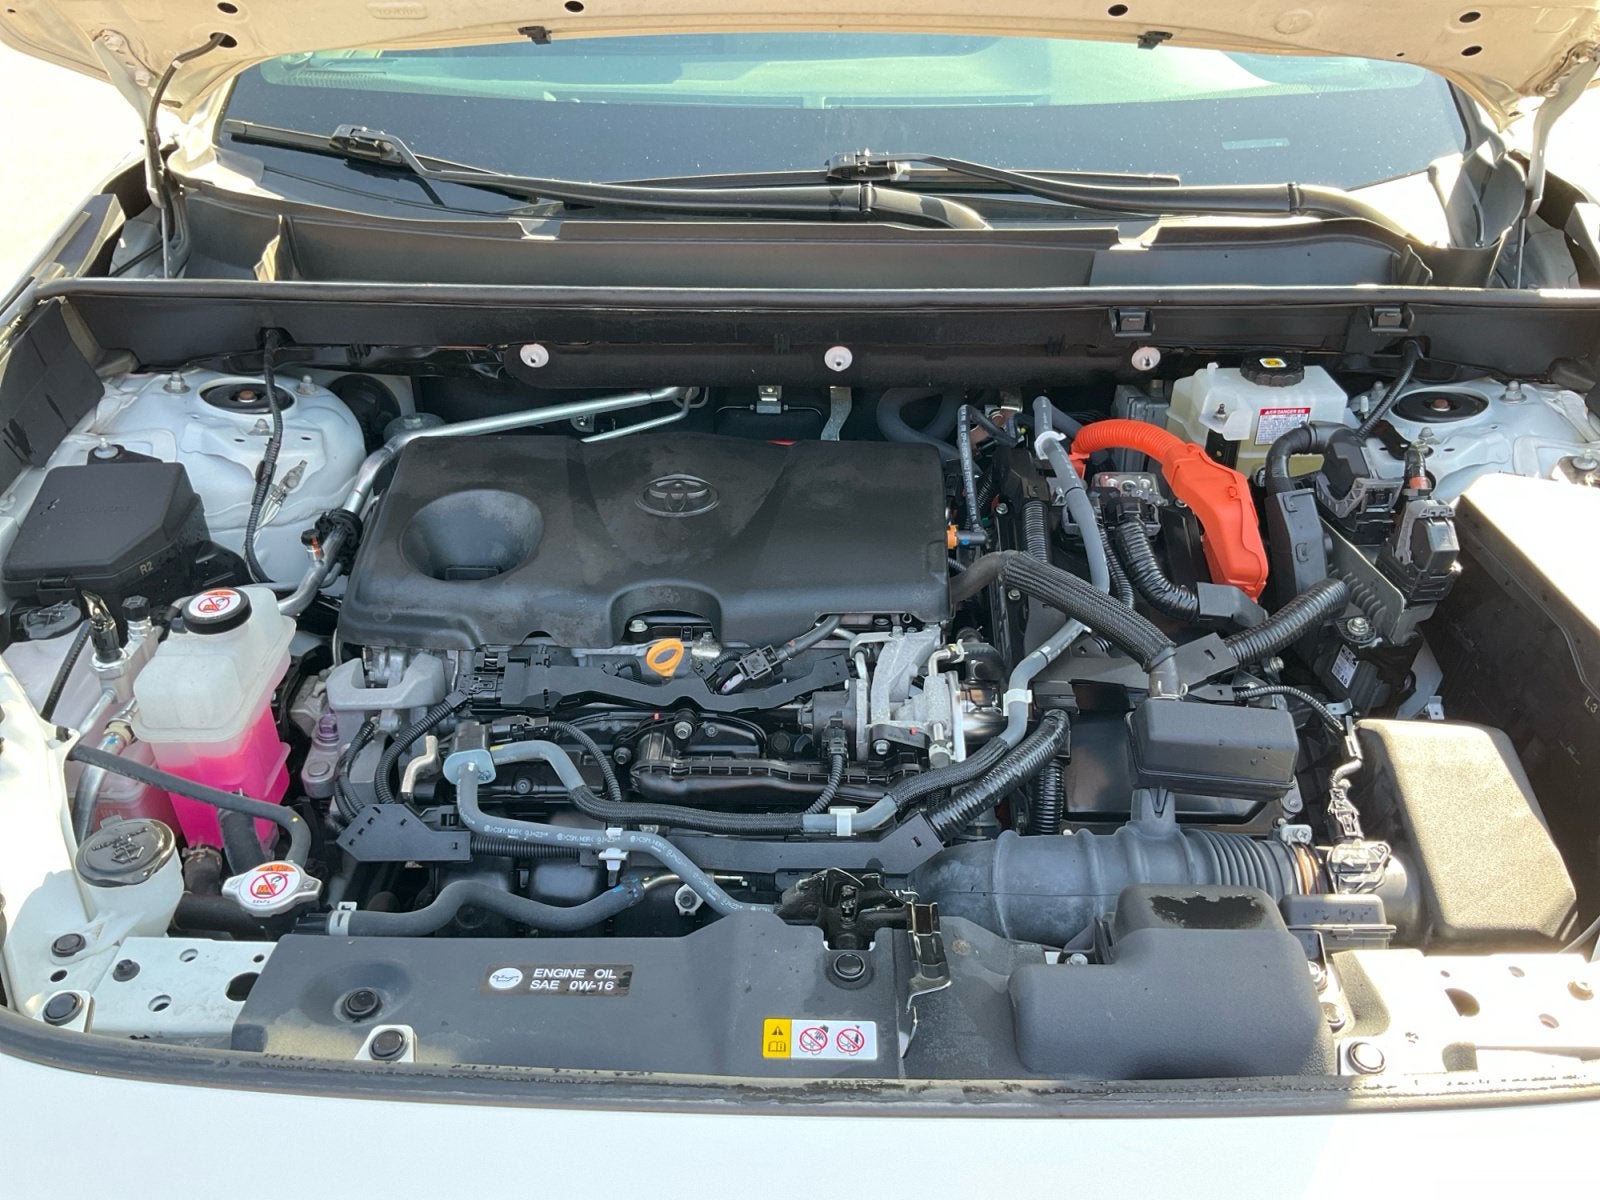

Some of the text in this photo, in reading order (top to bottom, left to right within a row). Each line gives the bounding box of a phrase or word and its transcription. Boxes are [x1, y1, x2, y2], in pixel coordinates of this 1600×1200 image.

[139, 561, 154, 575] R2
[1584, 695, 1598, 713] L3
[533, 968, 617, 979] ENGINE OIL
[529, 980, 615, 991] SAE 0W-16
